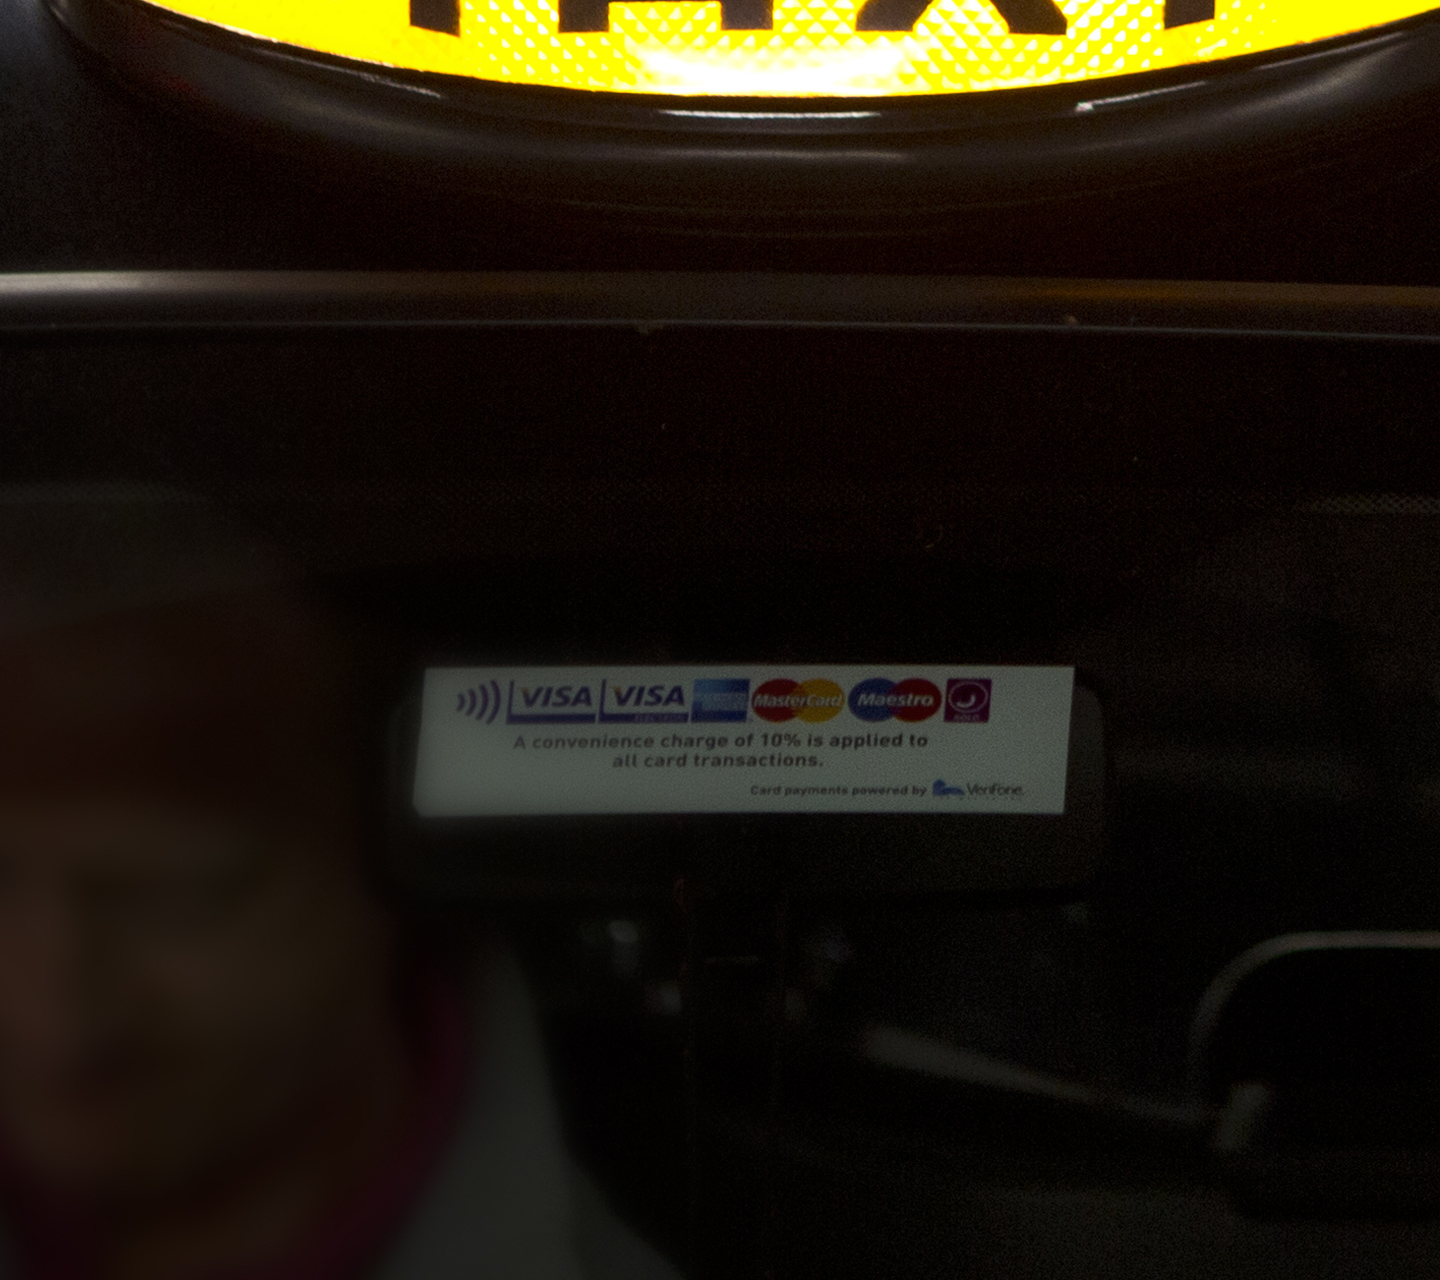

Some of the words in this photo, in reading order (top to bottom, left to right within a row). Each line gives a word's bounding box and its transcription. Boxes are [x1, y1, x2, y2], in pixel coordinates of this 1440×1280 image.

[521, 686, 593, 707] VISA
[613, 685, 686, 706] VISA
[754, 692, 844, 707] MasterCard
[857, 692, 934, 707] Maestro
[513, 735, 527, 749] A
[532, 734, 655, 749] convenience
[660, 733, 728, 750] charge
[734, 733, 754, 747] of
[761, 733, 801, 747] 10%
[807, 733, 823, 747] is
[829, 733, 903, 750] applied
[909, 734, 928, 747] to
[613, 754, 637, 768] all
[644, 754, 687, 768] card
[694, 753, 824, 767] transactions.
[750, 785, 781, 795] Card
[785, 786, 848, 797] payments
[852, 785, 908, 797] powered
[912, 785, 927, 798] by
